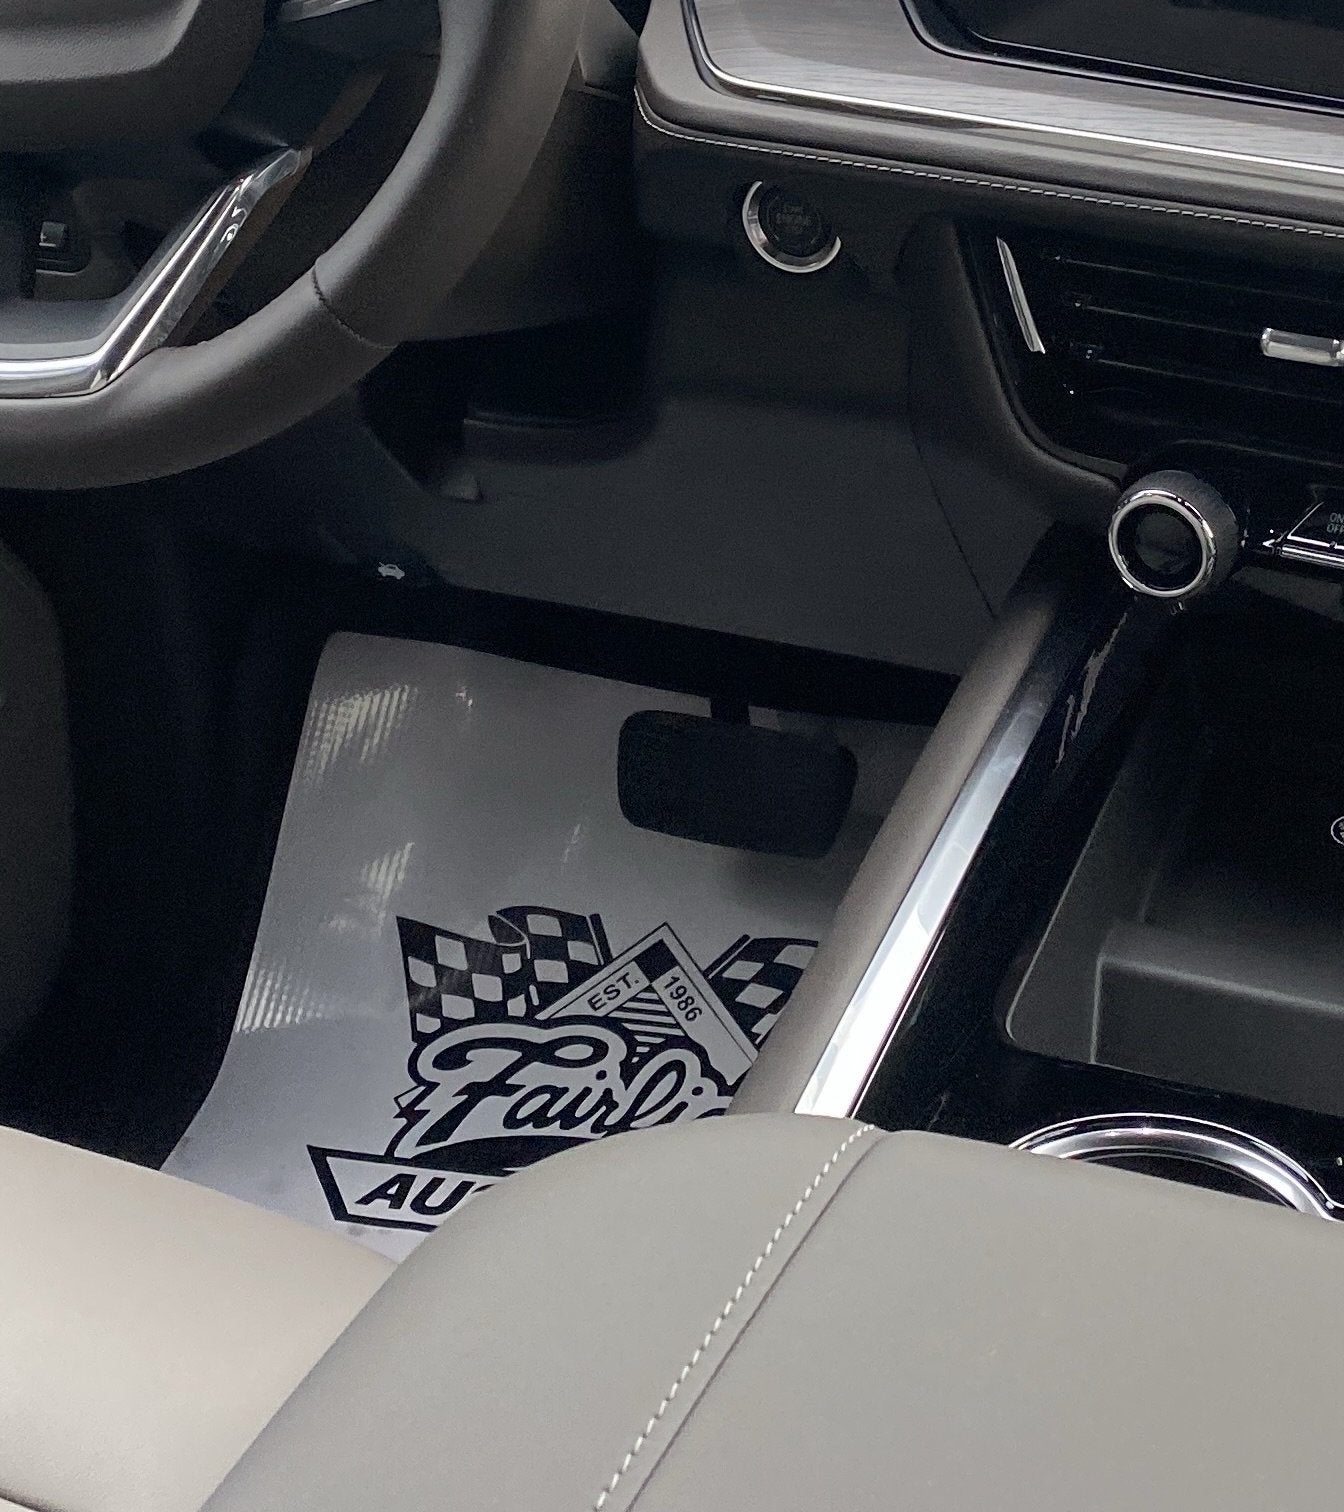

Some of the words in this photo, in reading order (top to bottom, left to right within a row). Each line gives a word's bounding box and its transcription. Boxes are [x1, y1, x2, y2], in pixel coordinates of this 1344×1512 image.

[586, 971, 641, 1012] EST.
[663, 975, 703, 1023] 1986
[356, 1172, 496, 1216] AU
